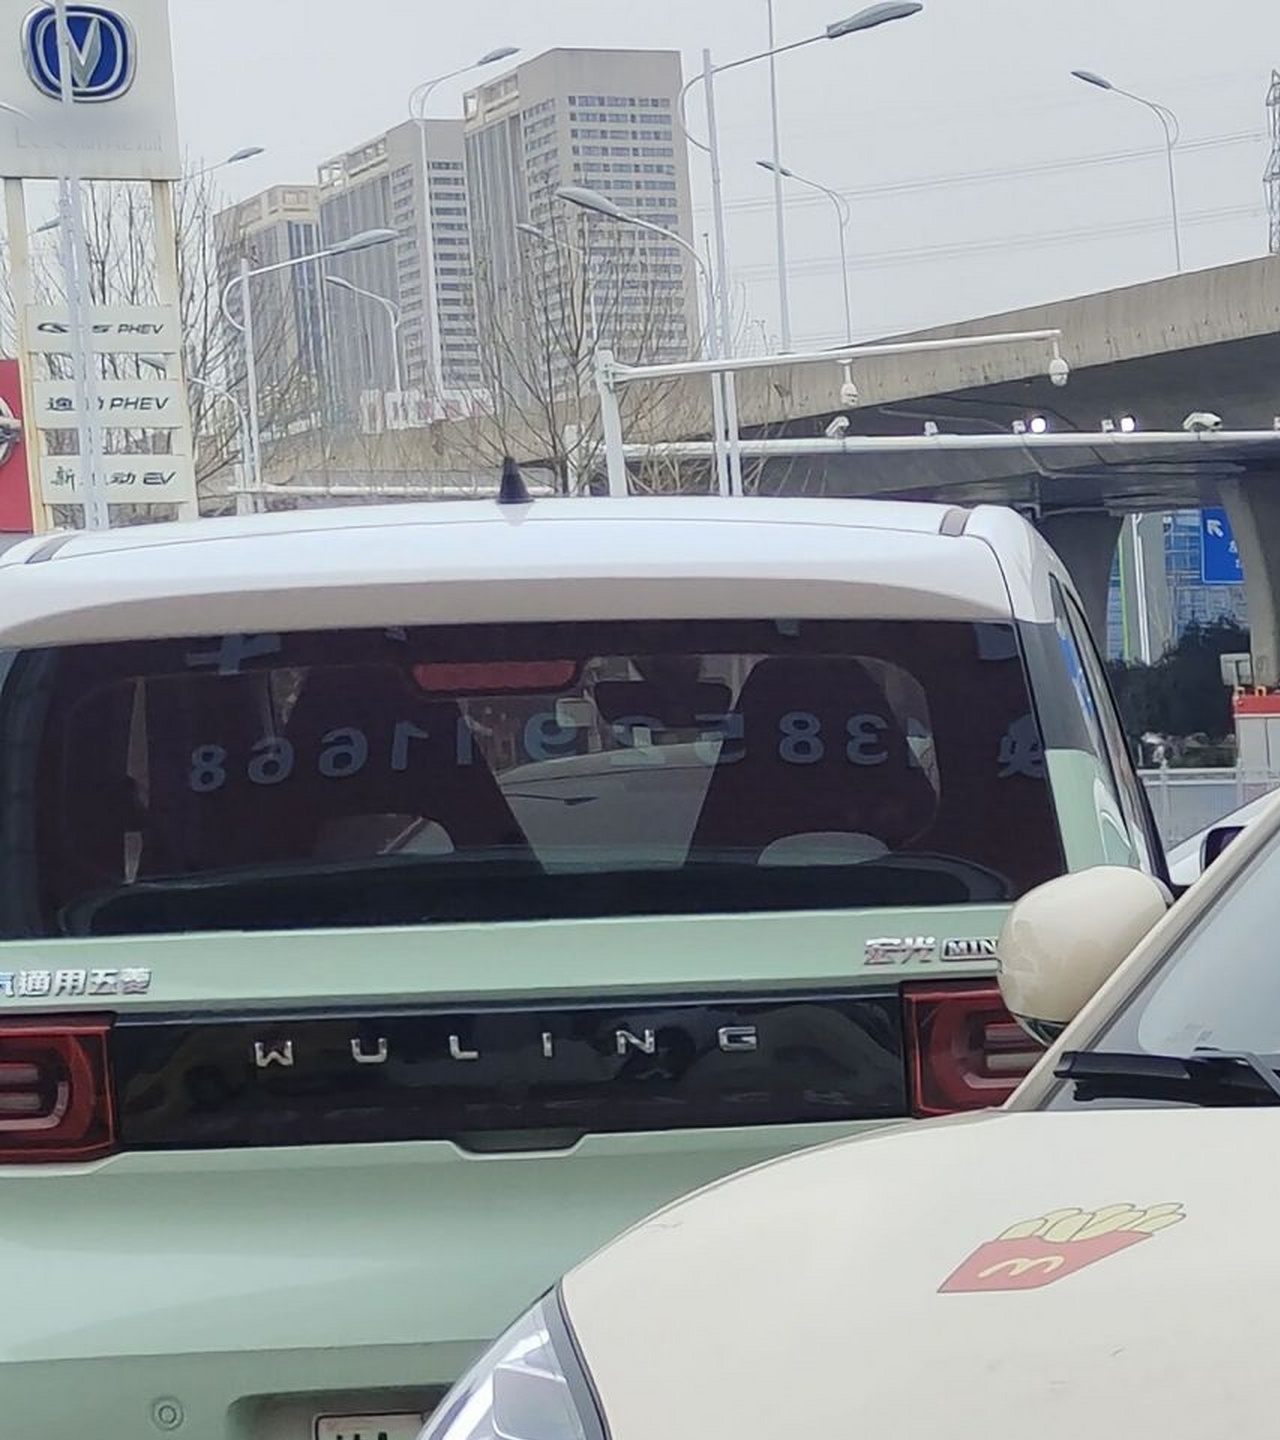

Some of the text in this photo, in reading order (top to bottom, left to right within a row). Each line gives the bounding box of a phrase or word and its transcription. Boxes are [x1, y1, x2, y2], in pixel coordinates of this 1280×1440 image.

[117, 323, 164, 335] PHEV
[109, 396, 169, 411] PHEV
[51, 465, 176, 491] 新动 EV
[254, 1026, 757, 1067] WULING
